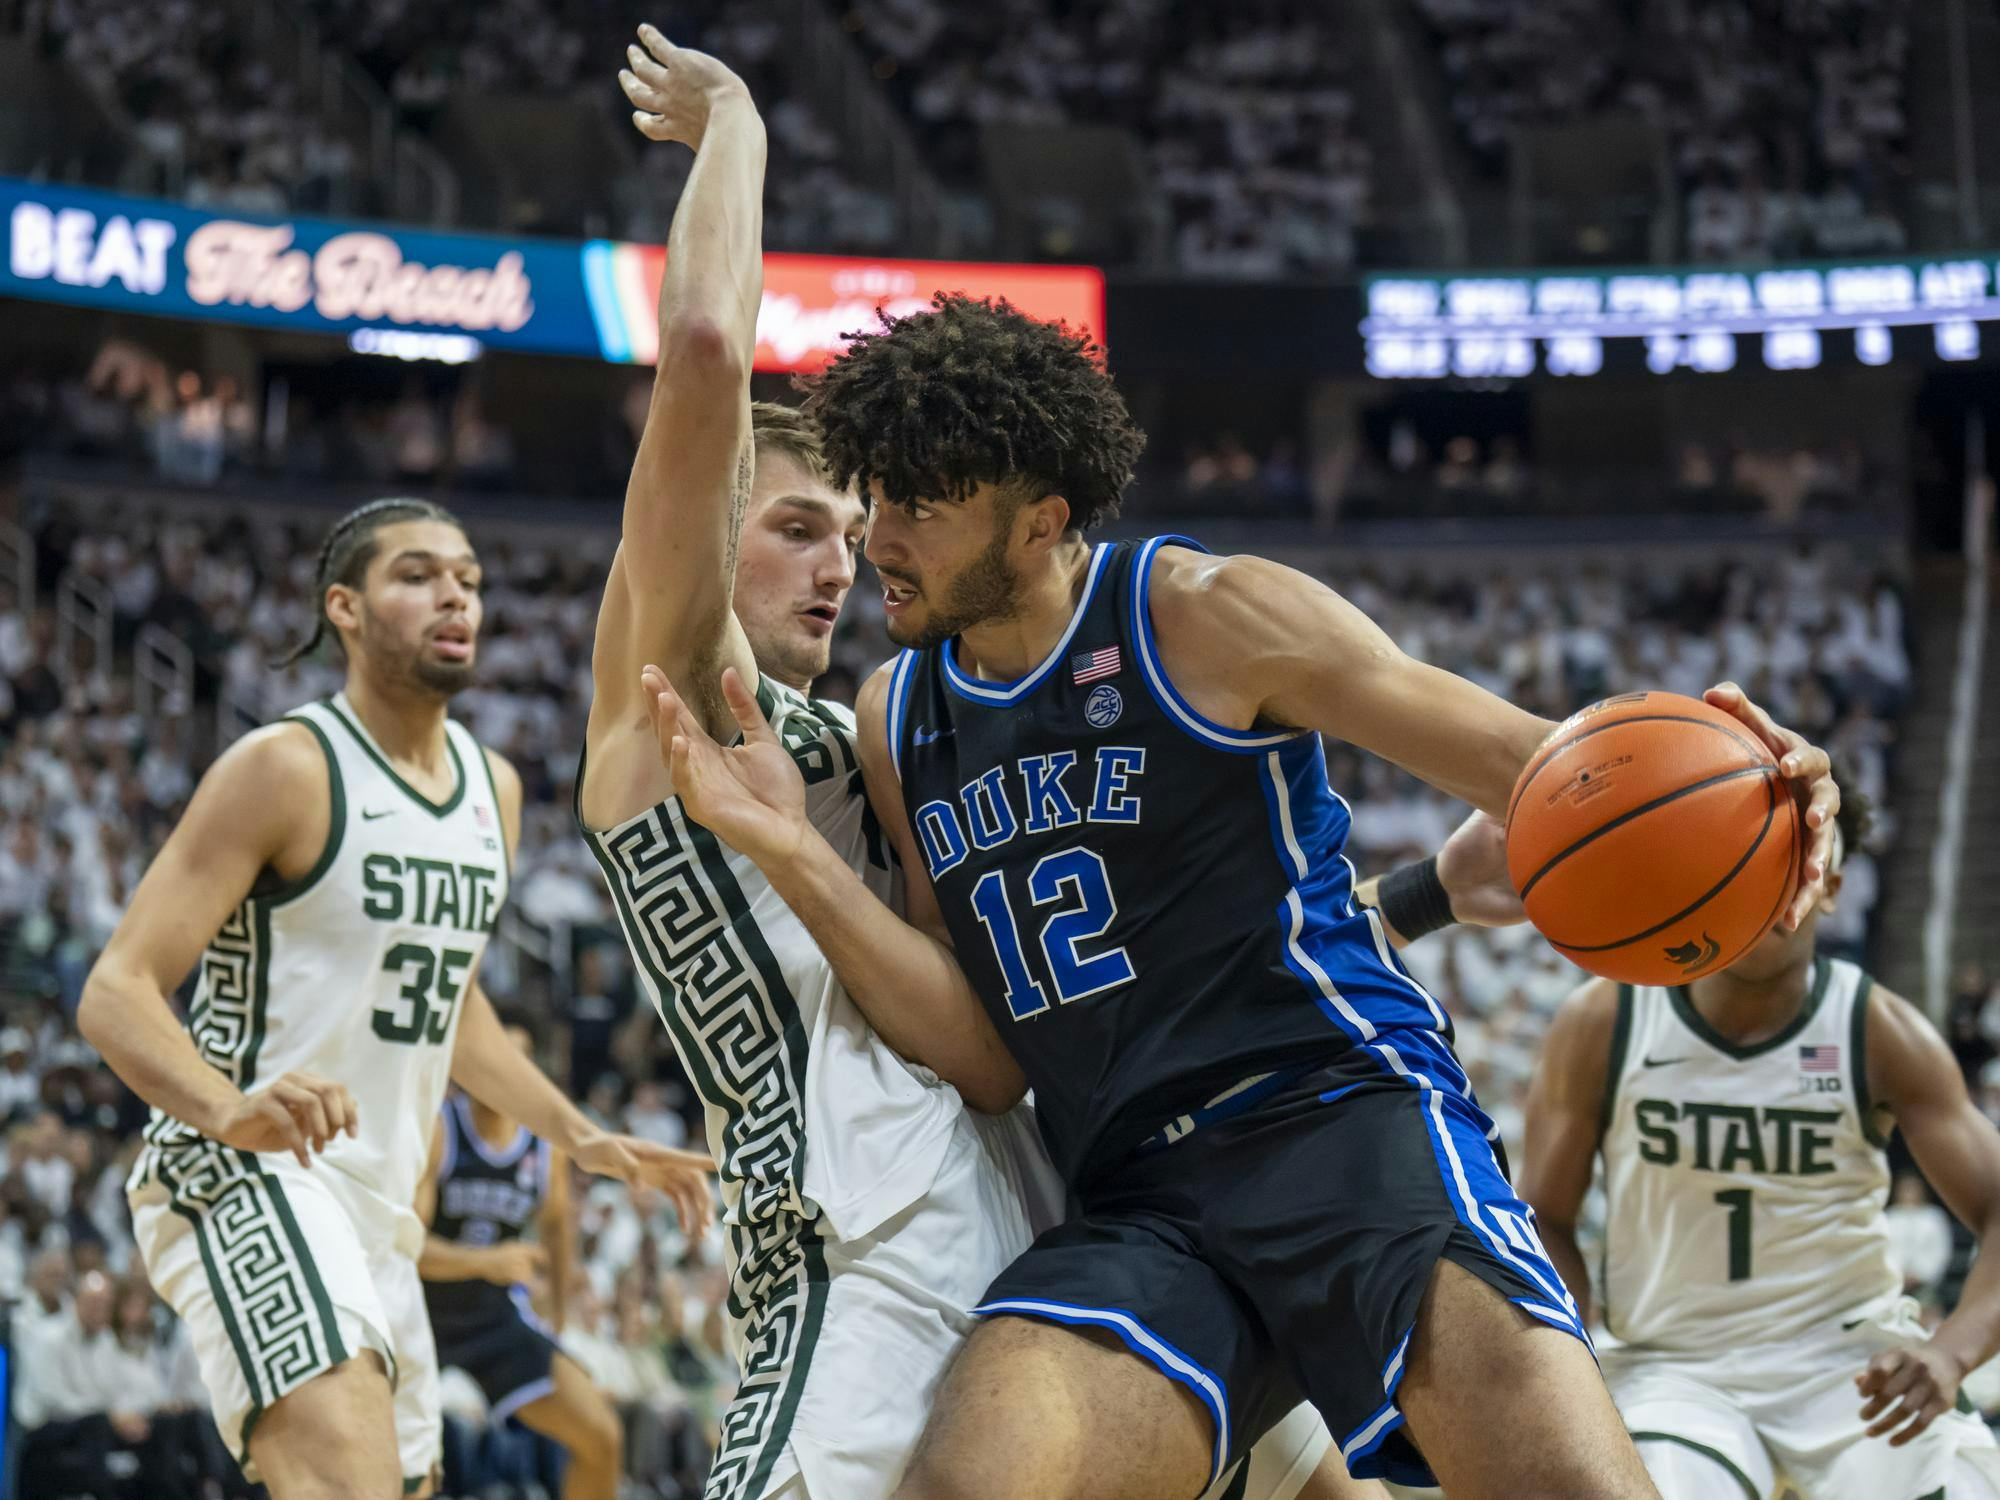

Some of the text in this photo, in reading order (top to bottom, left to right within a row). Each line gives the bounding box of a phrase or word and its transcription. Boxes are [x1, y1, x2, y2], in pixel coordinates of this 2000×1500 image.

[10, 201, 176, 294] BEAT
[184, 220, 312, 312] The
[915, 747, 1146, 882] DUKE
[363, 853, 497, 932] STATE
[970, 846, 1136, 1022] 12
[371, 942, 474, 1045] 35
[1635, 1099, 1843, 1176] STATE
[1713, 1189, 1754, 1282] 1
